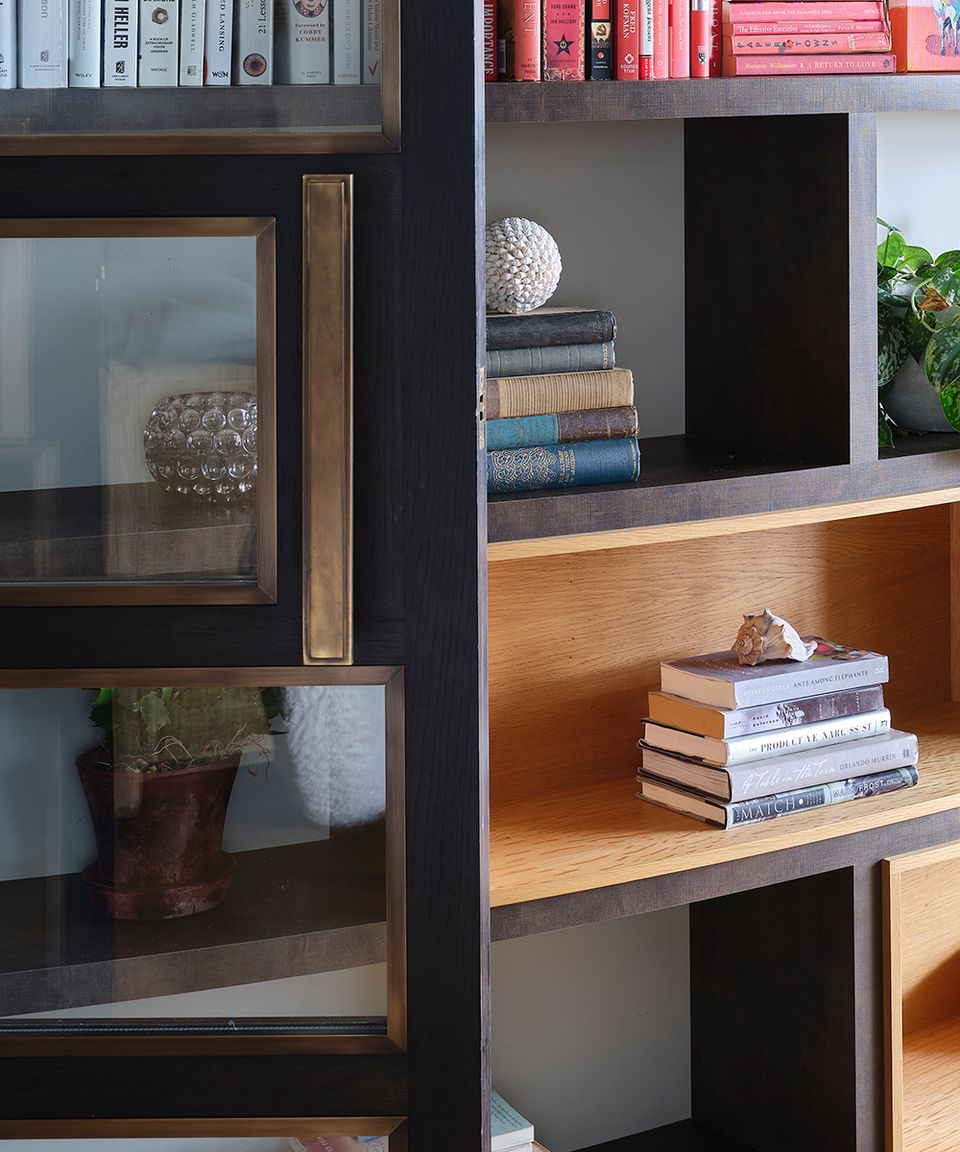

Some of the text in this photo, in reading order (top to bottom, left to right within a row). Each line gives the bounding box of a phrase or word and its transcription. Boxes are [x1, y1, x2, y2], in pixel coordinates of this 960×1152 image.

[113, 7, 129, 49] HELLER
[218, 13, 226, 52] LANSING
[622, 3, 630, 39] KOFMAN
[483, 4, 494, 75] IMPORTANCE
[737, 40, 782, 48] PAPER
[795, 39, 838, 47] TOWNS
[814, 61, 843, 69] RETURN
[793, 670, 869, 688] ANTS AMONG ELEPHANTS
[839, 753, 897, 771] ORLANDO MURRIN
[740, 798, 796, 822] MATCH
